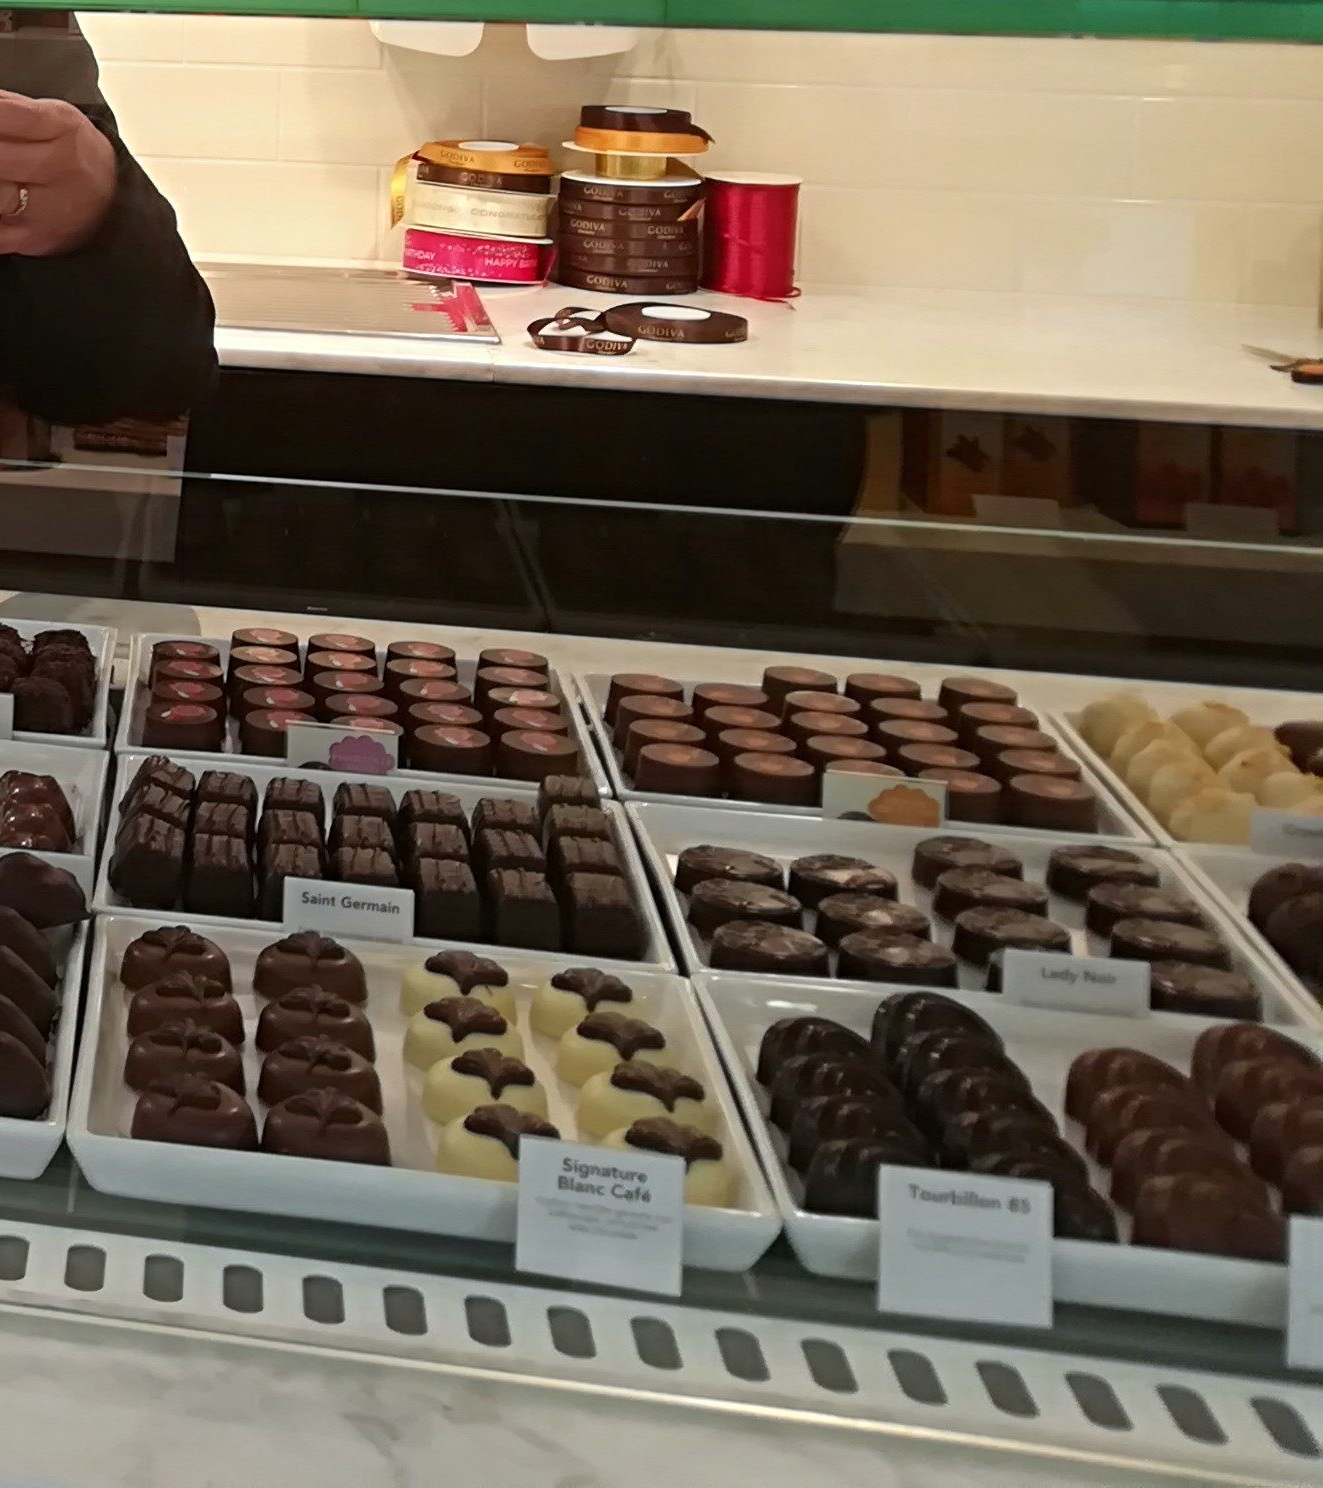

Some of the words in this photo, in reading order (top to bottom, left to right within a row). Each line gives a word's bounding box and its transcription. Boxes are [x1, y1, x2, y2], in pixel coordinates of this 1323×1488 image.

[570, 219, 605, 231] GODIVA
[586, 275, 628, 288] GODIVA
[638, 325, 684, 338] GODIVA
[301, 891, 335, 907] Saint
[341, 896, 401, 914] Germain
[562, 1157, 648, 1183] Signature
[558, 1175, 605, 1196] Blanc
[611, 1183, 652, 1203] Café
